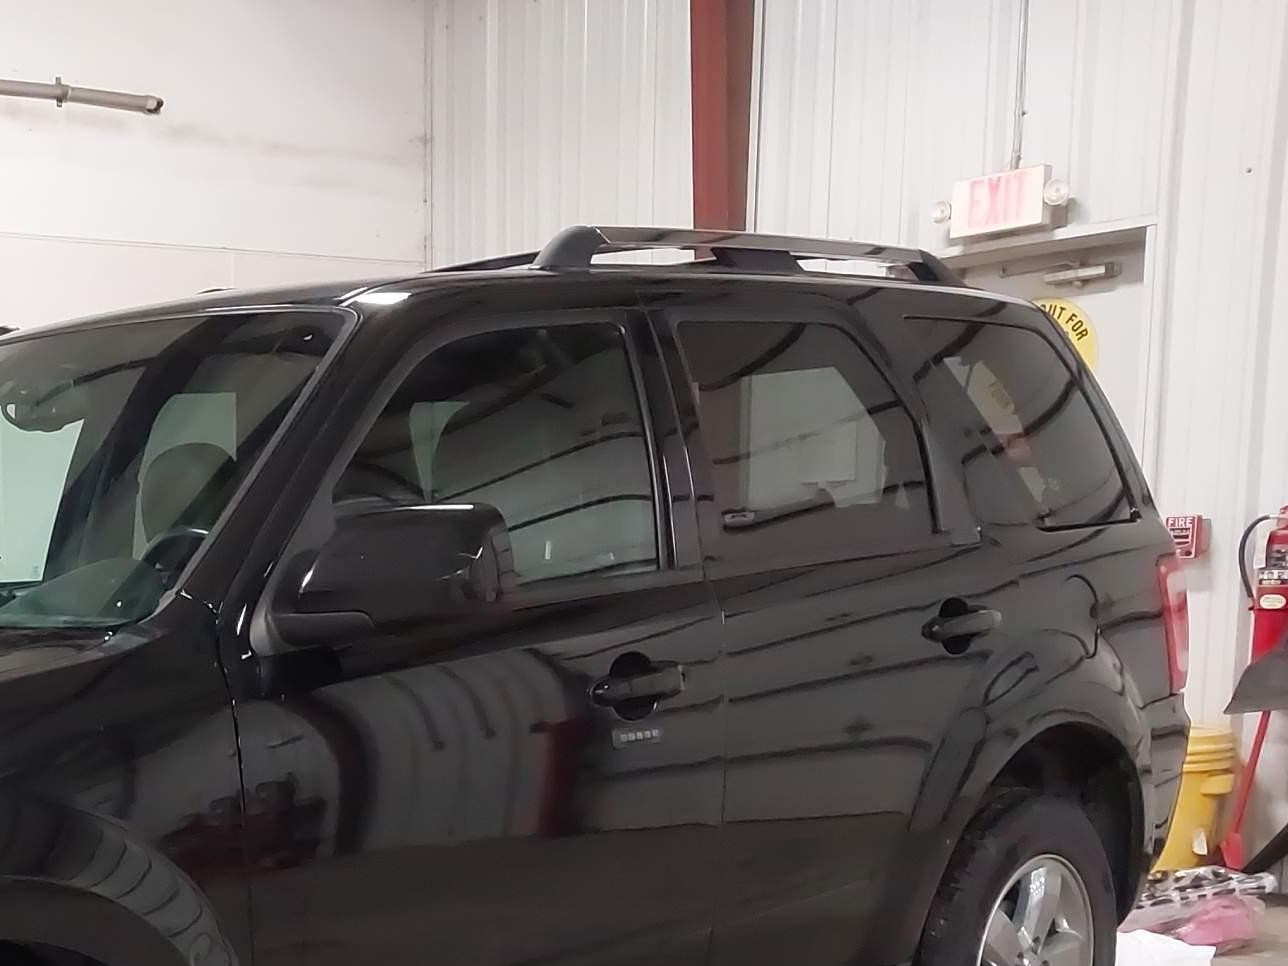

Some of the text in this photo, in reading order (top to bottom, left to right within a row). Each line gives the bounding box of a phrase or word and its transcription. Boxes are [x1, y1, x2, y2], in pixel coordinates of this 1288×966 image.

[967, 169, 1029, 229] EXIT
[1064, 312, 1089, 341] FOR
[1167, 517, 1193, 529] FIRE
